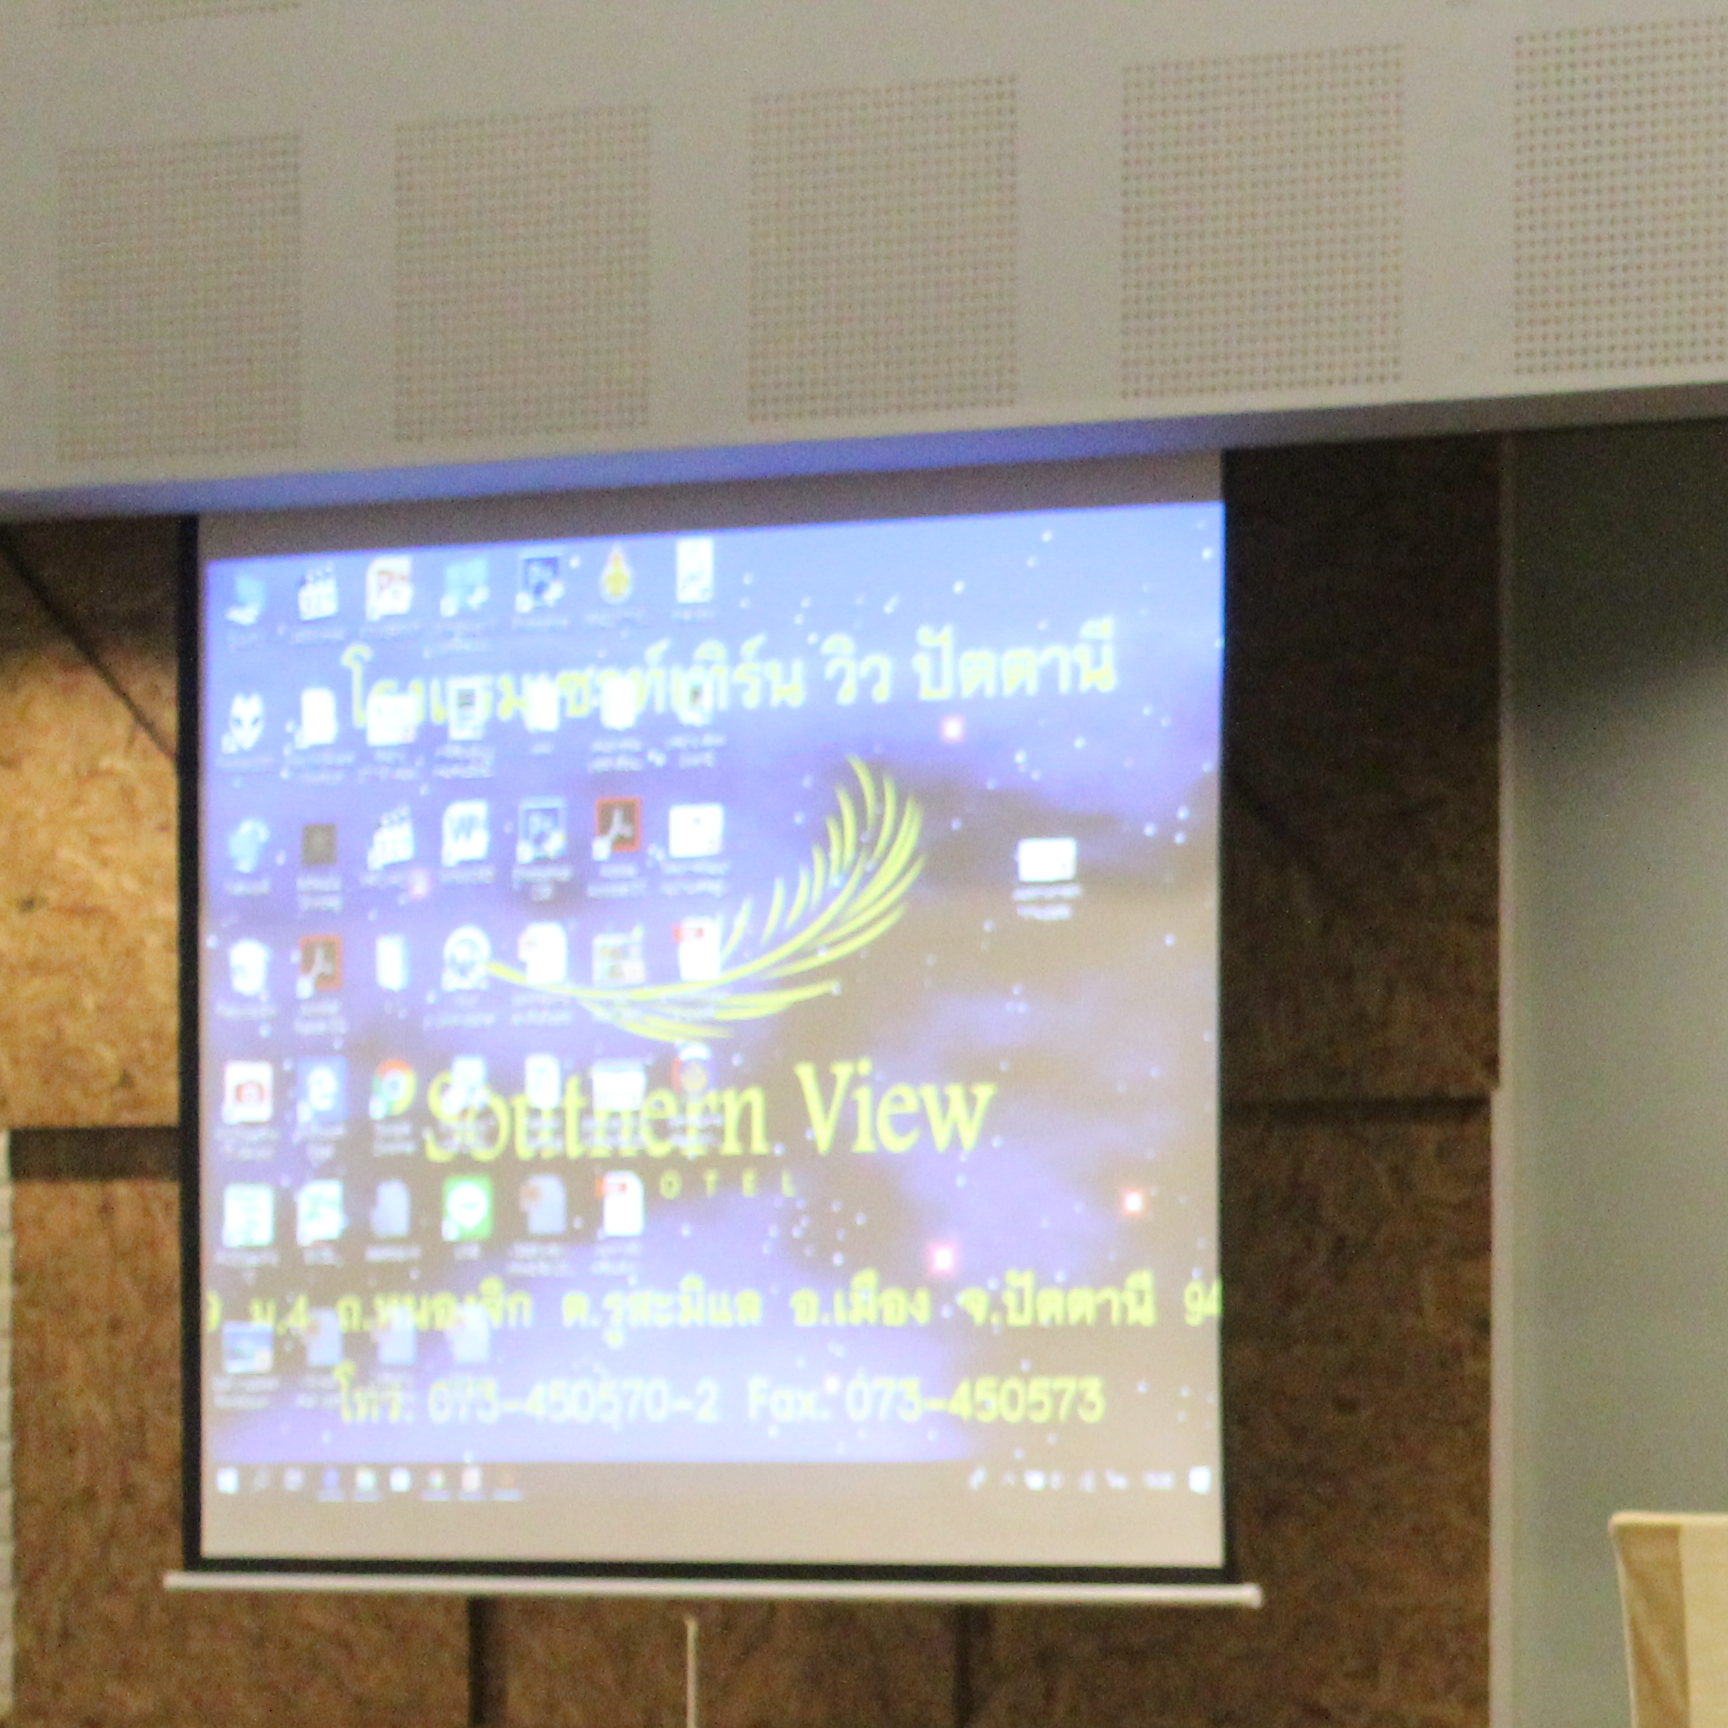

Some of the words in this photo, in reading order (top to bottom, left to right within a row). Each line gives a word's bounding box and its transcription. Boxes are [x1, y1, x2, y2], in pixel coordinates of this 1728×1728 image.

[912, 615, 1116, 701] ปัตตานี
[794, 1055, 996, 1156] View
[843, 1374, 1107, 1424] 073-450573
